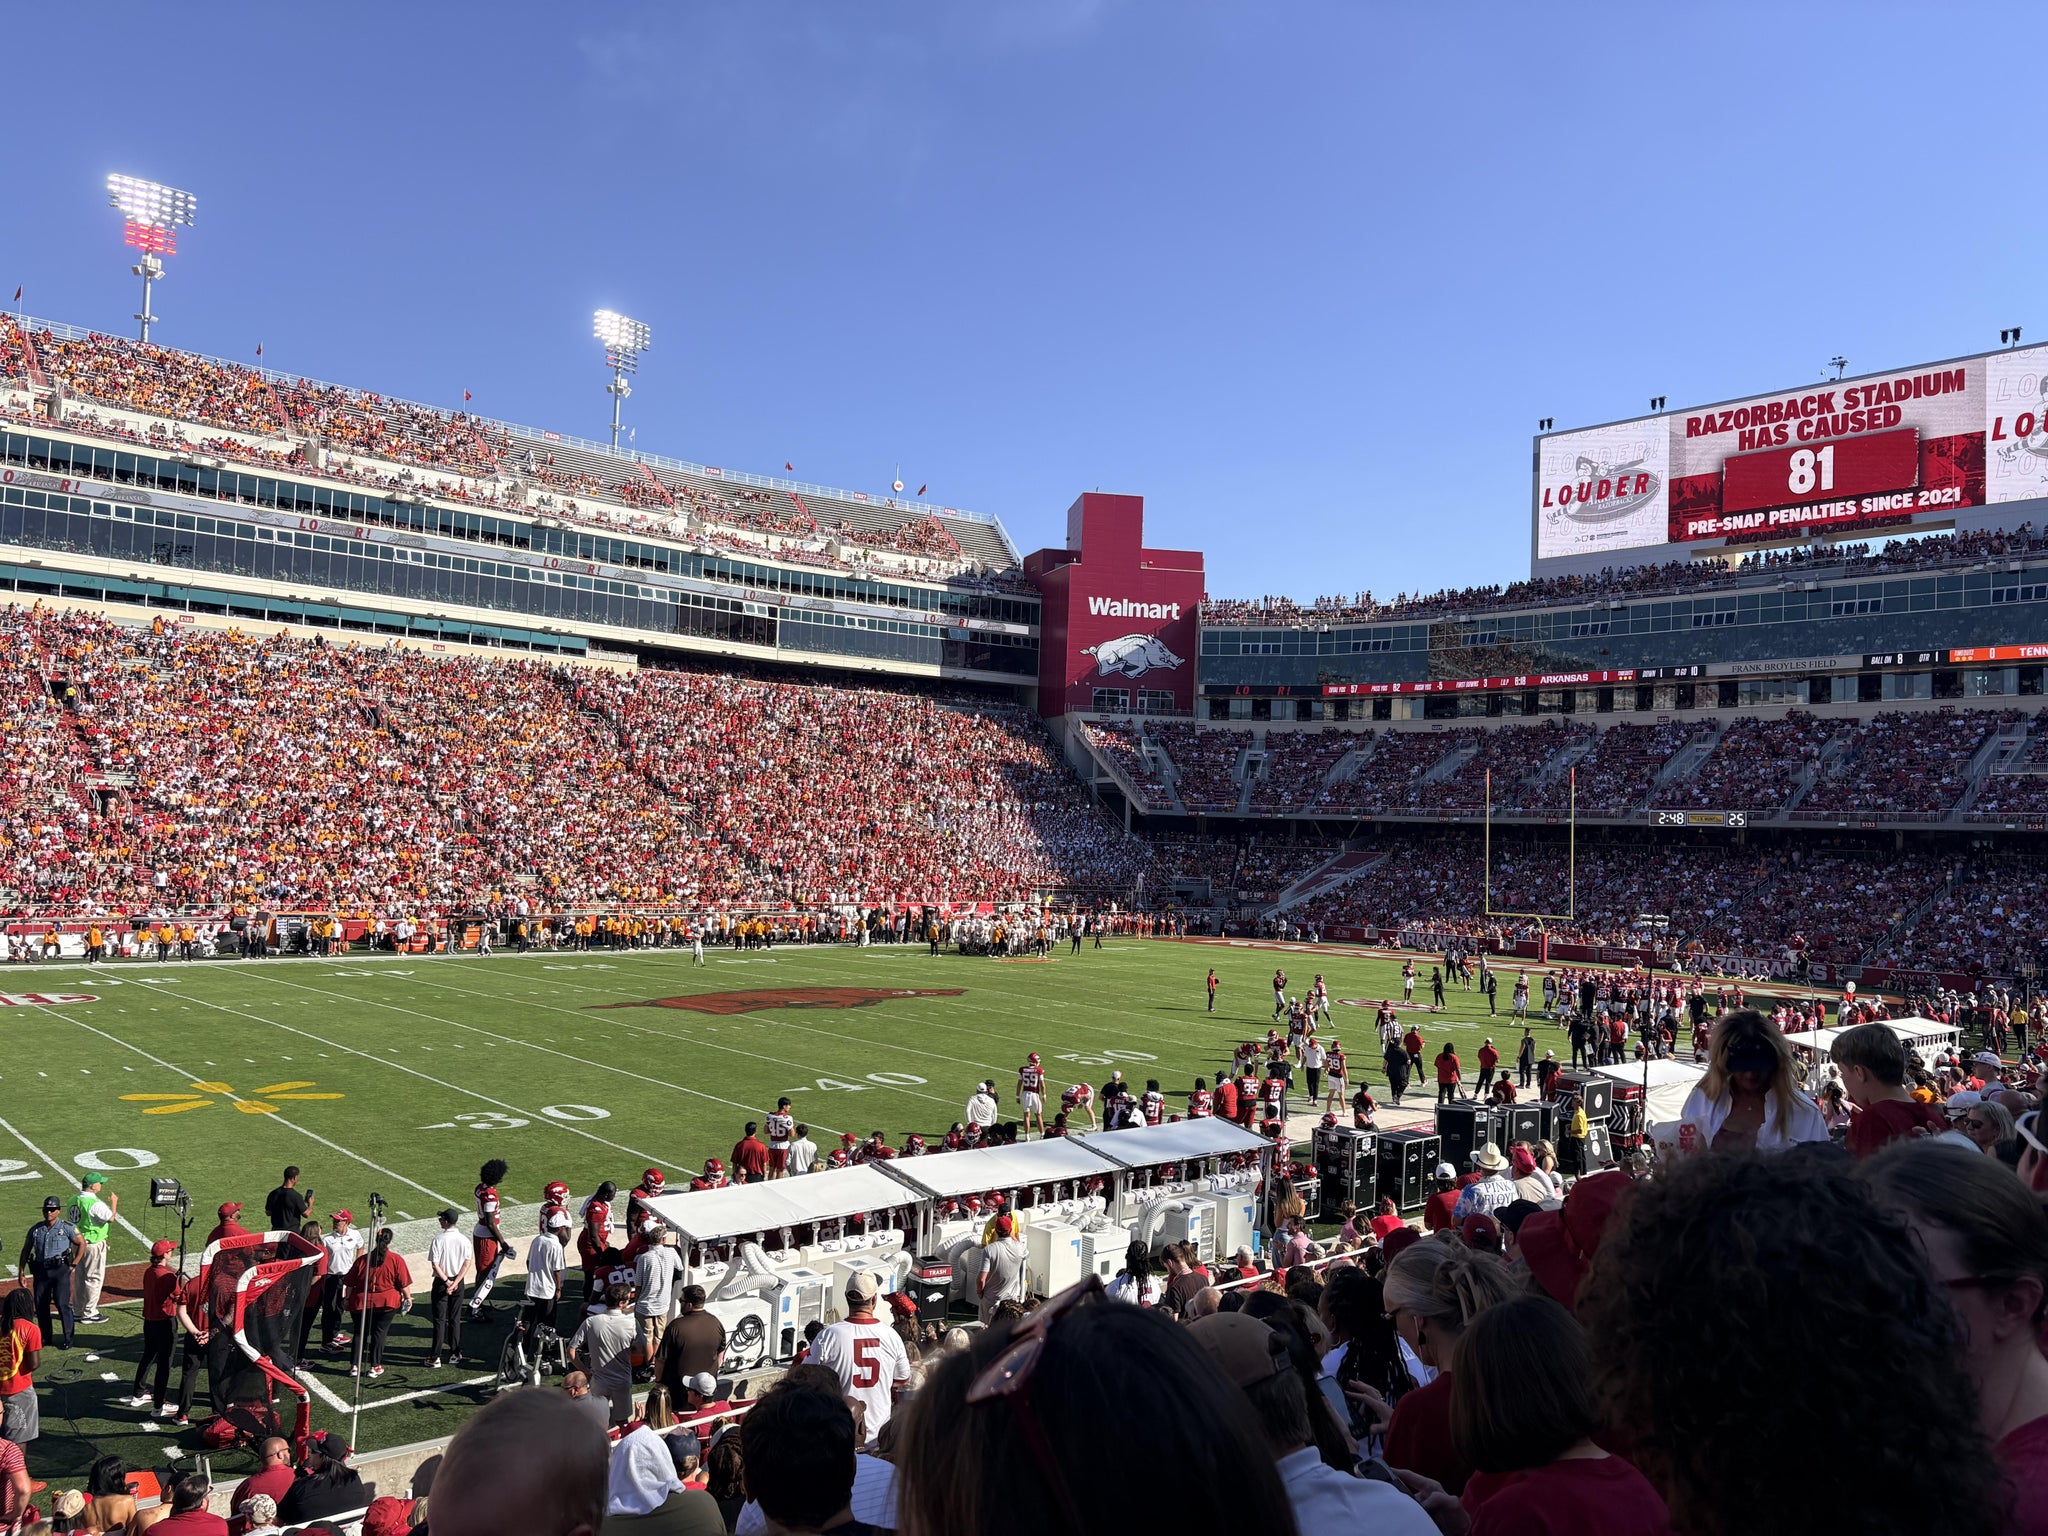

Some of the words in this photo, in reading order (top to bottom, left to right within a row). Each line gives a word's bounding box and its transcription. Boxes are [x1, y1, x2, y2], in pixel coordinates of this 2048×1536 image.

[1687, 391, 1836, 438] RAZORBACK
[1843, 368, 1965, 410] STADIUM
[1738, 424, 1789, 451] HAS
[1797, 405, 1902, 442] CAUSED
[1788, 446, 1834, 494] 81
[1543, 473, 1649, 507] LOUDER
[1688, 513, 1765, 535] PRE-SNAP
[1769, 500, 1857, 524] PENALTIES
[1862, 493, 1914, 514] SINCE
[1918, 487, 1961, 506] 2021
[1088, 597, 1180, 620] Walmart
[1871, 656, 1884, 664] BALL
[1884, 655, 1892, 664] ON
[1897, 653, 1903, 664] 8
[1918, 653, 1930, 662] QTR
[1989, 648, 1995, 659] 0
[2019, 646, 2048, 656] TENN
[1642, 670, 1656, 678] DOWN
[1690, 666, 1698, 676] 10
[1732, 664, 1762, 673] FRANK
[1764, 661, 1807, 671] BROYLES
[1809, 659, 1837, 667] FIELD
[1350, 685, 1358, 693] 57
[1483, 679, 1488, 687] 3
[1540, 674, 1589, 684] ARKANSAS
[1602, 671, 1608, 681] 0
[1658, 812, 1684, 824] 2:48
[1728, 813, 1744, 825] 25
[1398, 932, 1478, 950] ARKANSAS
[1053, 1050, 1158, 1065] 50
[815, 1072, 928, 1091] 40
[1023, 1073, 1038, 1087] 59
[1243, 1084, 1258, 1095] 95
[454, 1104, 612, 1130] 30
[1145, 1101, 1159, 1117] 21
[769, 1121, 786, 1137] 46
[1484, 1182, 1511, 1192] PINK
[852, 1338, 881, 1388] 5
